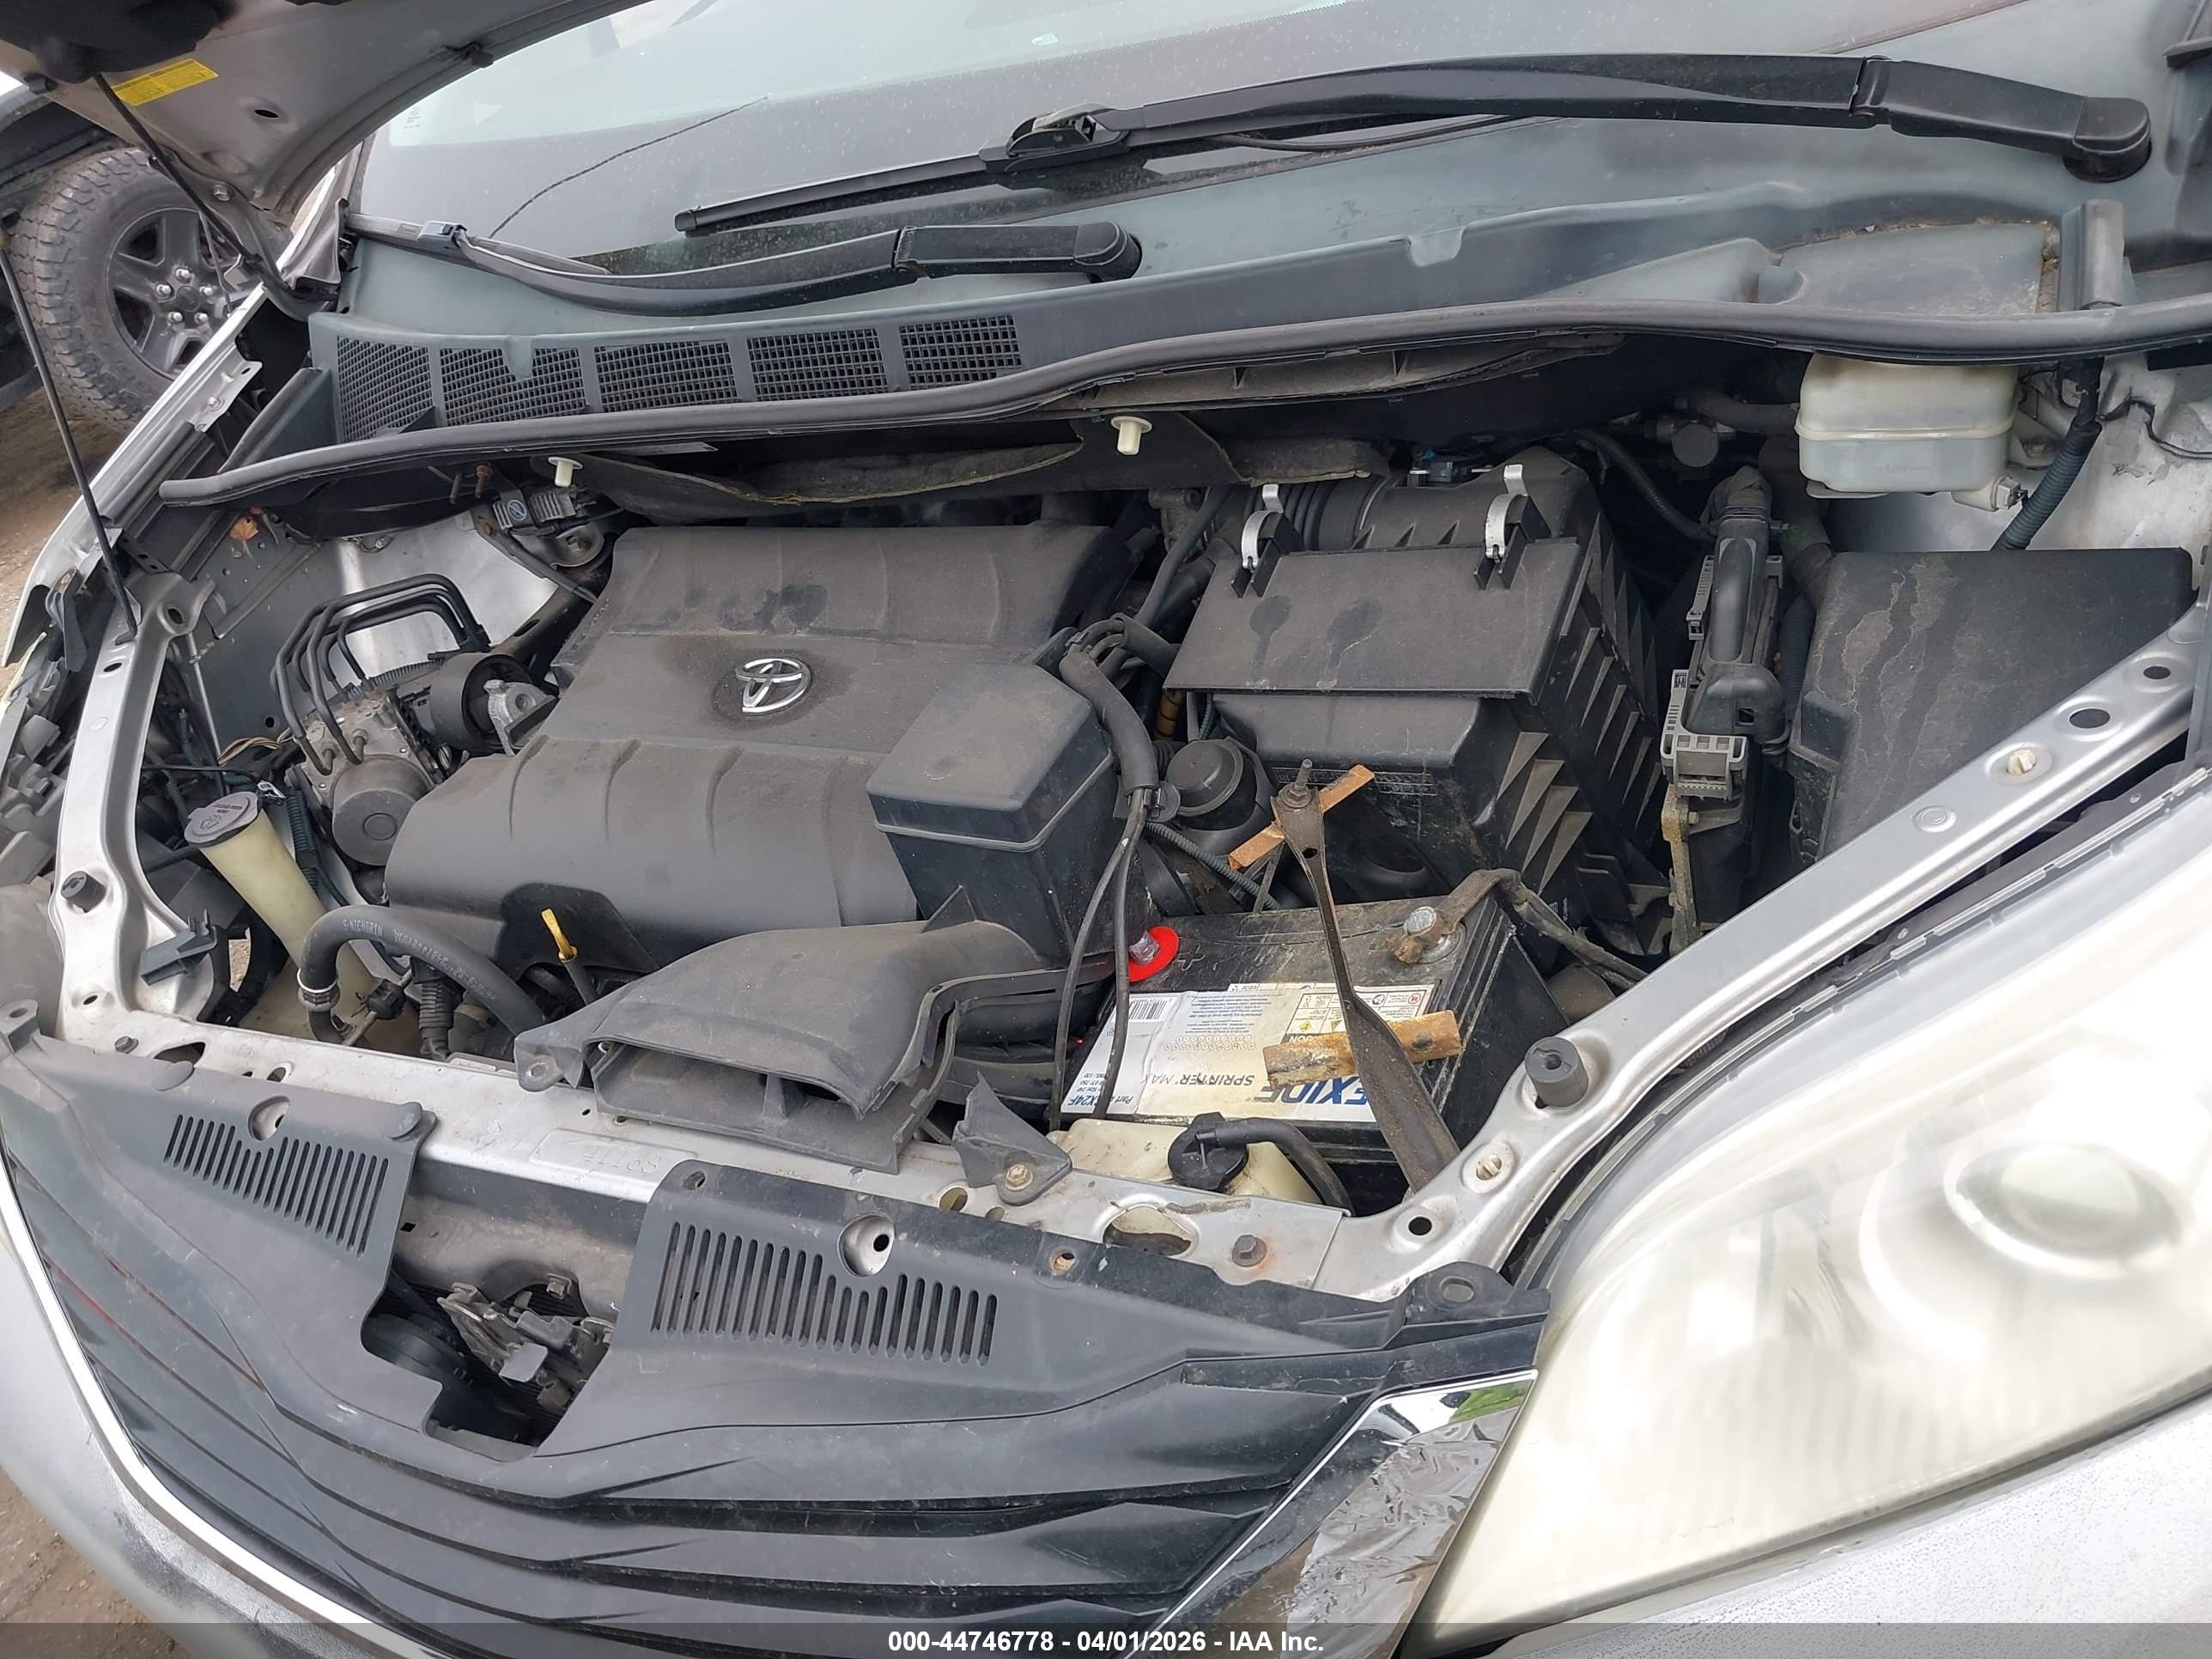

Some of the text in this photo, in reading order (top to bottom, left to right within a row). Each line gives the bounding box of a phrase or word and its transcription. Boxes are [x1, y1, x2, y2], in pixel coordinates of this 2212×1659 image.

[1139, 1073, 1255, 1085] SPRINTER MAX
[1252, 1076, 1368, 1105] EXIDE
[1067, 1095, 1134, 1106] Part X24F
